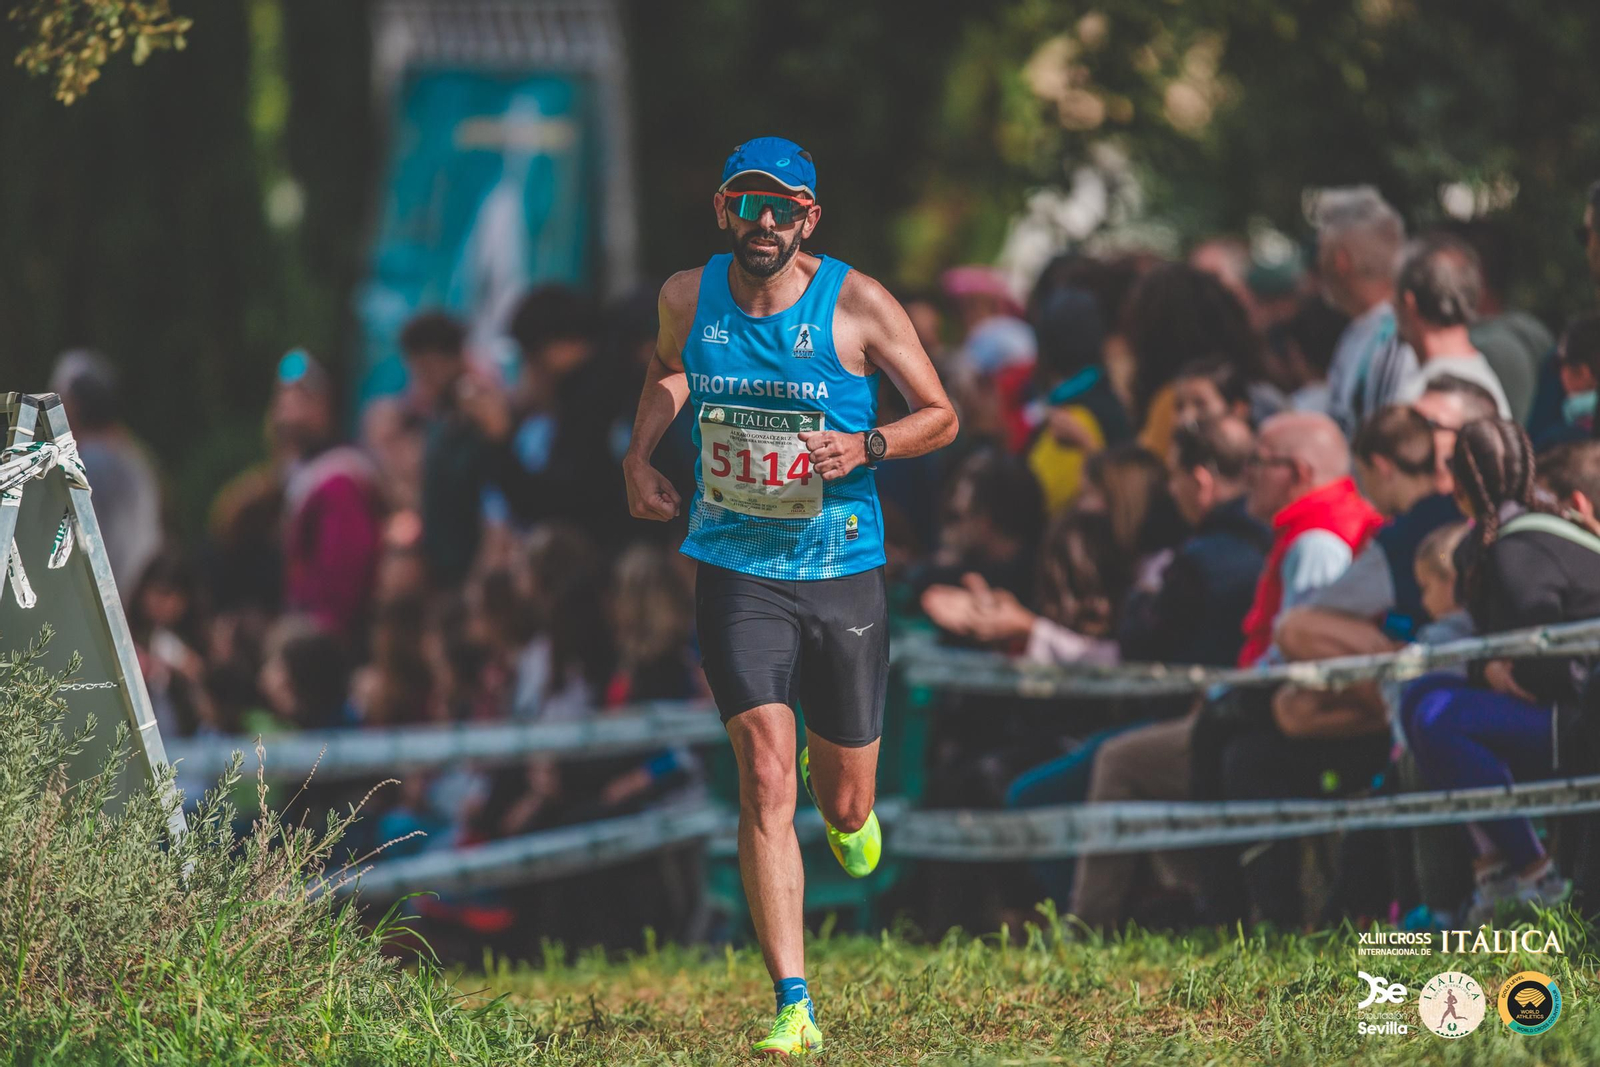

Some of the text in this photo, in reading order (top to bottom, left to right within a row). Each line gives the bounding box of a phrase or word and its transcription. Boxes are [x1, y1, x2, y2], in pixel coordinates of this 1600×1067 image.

[690, 372, 829, 400] TROTASIERRA
[732, 411, 790, 429] ITÁLICA
[711, 441, 813, 486] 5114
